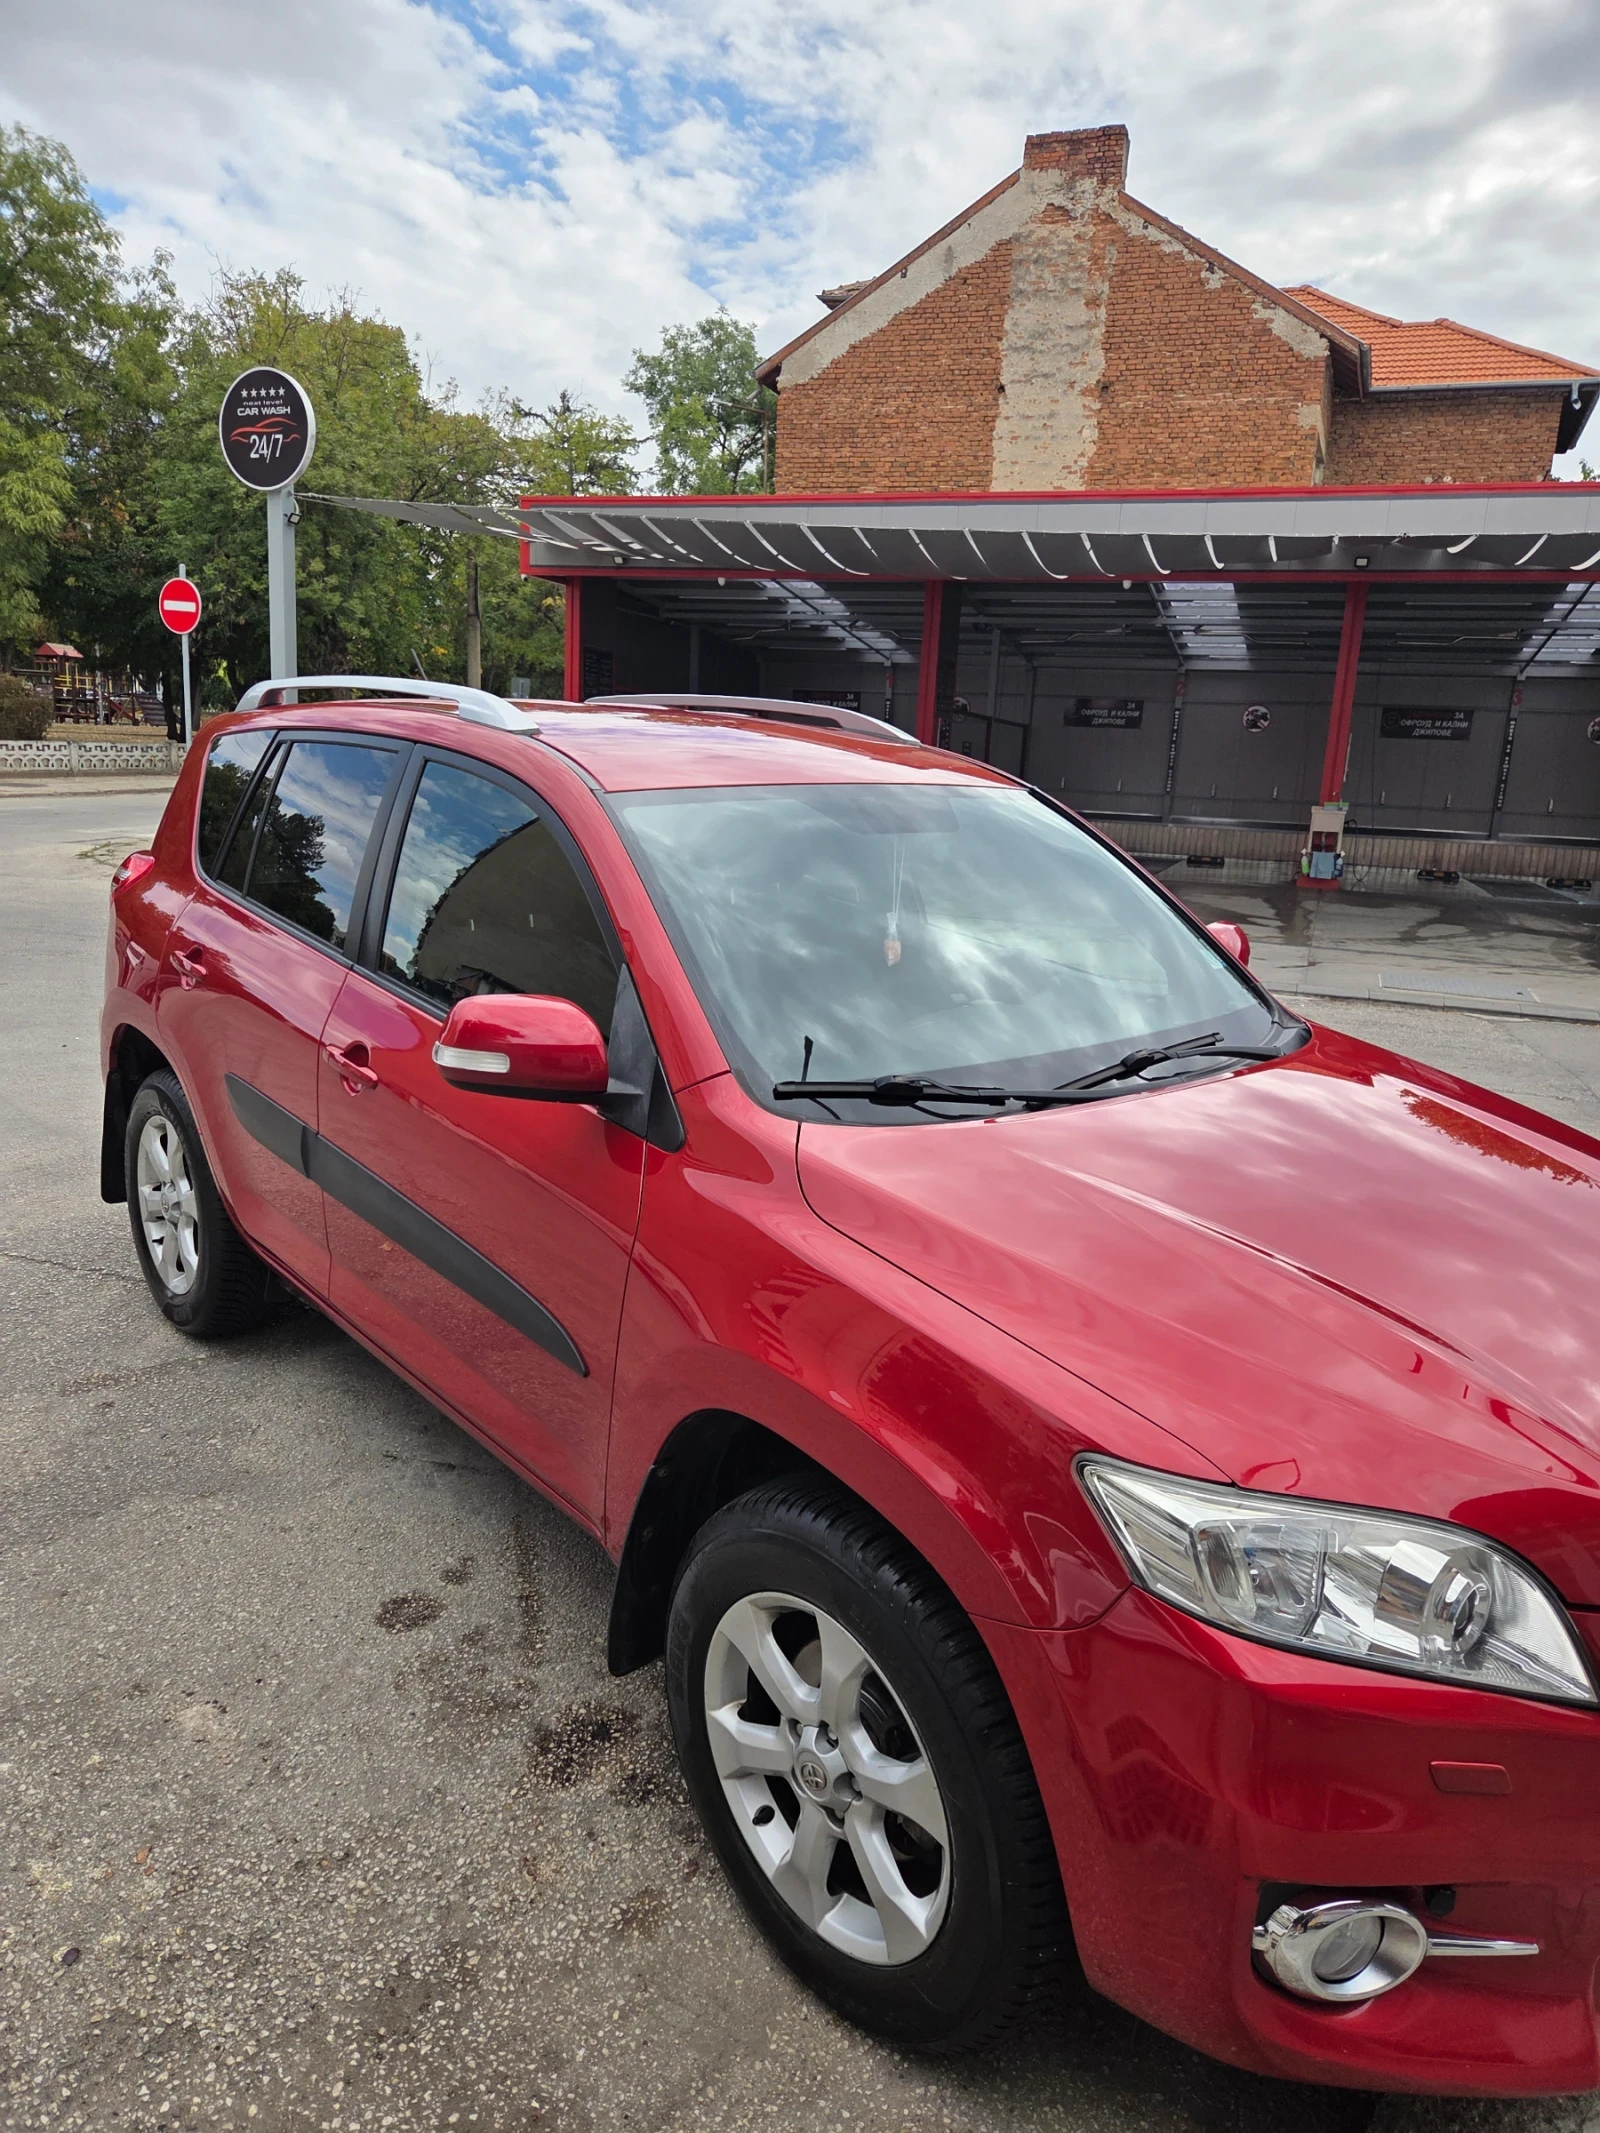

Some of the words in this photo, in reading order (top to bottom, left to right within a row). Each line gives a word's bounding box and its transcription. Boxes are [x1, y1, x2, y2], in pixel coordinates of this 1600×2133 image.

[237, 407, 259, 416] CAR
[261, 406, 291, 415] WASH
[250, 434, 283, 464] 24/7
[1081, 709, 1109, 717] ОФРОУД
[1453, 711, 1464, 719] ЗА
[1092, 717, 1126, 725] ДЖИПОВЕ
[1400, 719, 1432, 728] ОФРОУД
[1442, 720, 1469, 728] КАЛНИ
[1412, 728, 1453, 737] ДЖИПОВЕ
